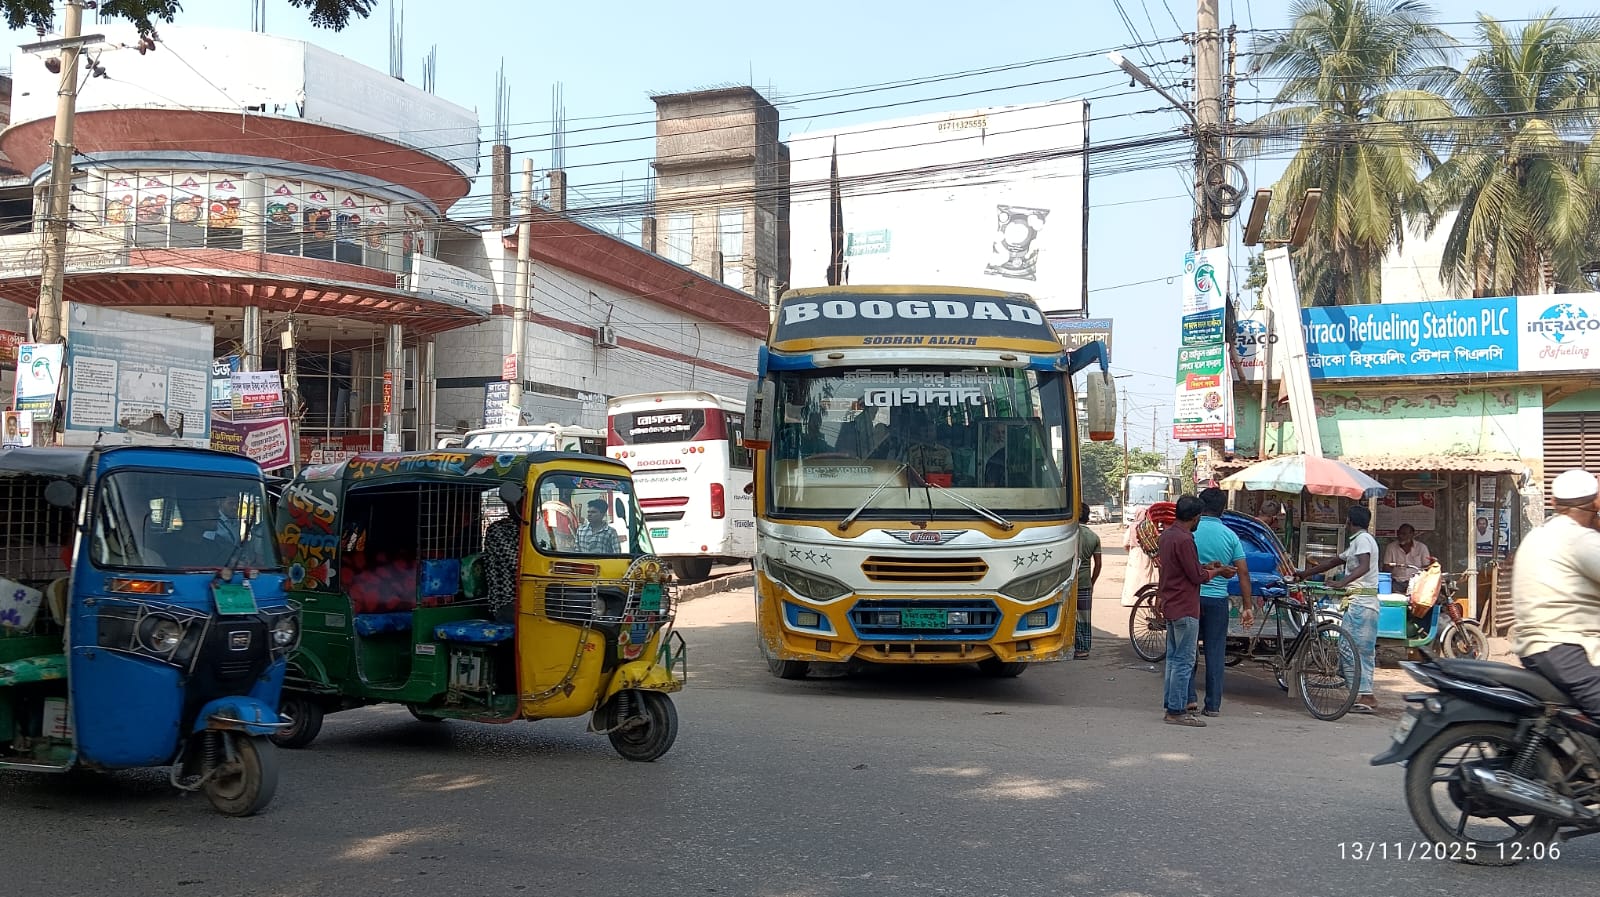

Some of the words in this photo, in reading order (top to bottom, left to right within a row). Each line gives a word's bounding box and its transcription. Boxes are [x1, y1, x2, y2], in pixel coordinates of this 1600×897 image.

[938, 119, 987, 130] 01711325555
[783, 299, 1043, 326] BOOGDAD
[1303, 321, 1346, 344] ntraco
[1349, 312, 1420, 347] Refueling
[1423, 309, 1477, 340] Station
[1481, 307, 1510, 337] PLC
[862, 336, 925, 346] SOBHAN
[928, 336, 978, 346] ALLAH
[1350, 348, 1408, 369] রিফুয়েলিং
[1410, 346, 1451, 364] স্টেশন
[1454, 344, 1505, 362] পিএলসি
[1539, 344, 1590, 360] Refueling
[863, 387, 982, 407] বোগদাদ
[637, 413, 683, 426] বোগদাদ
[636, 458, 681, 467] BOOGDAD
